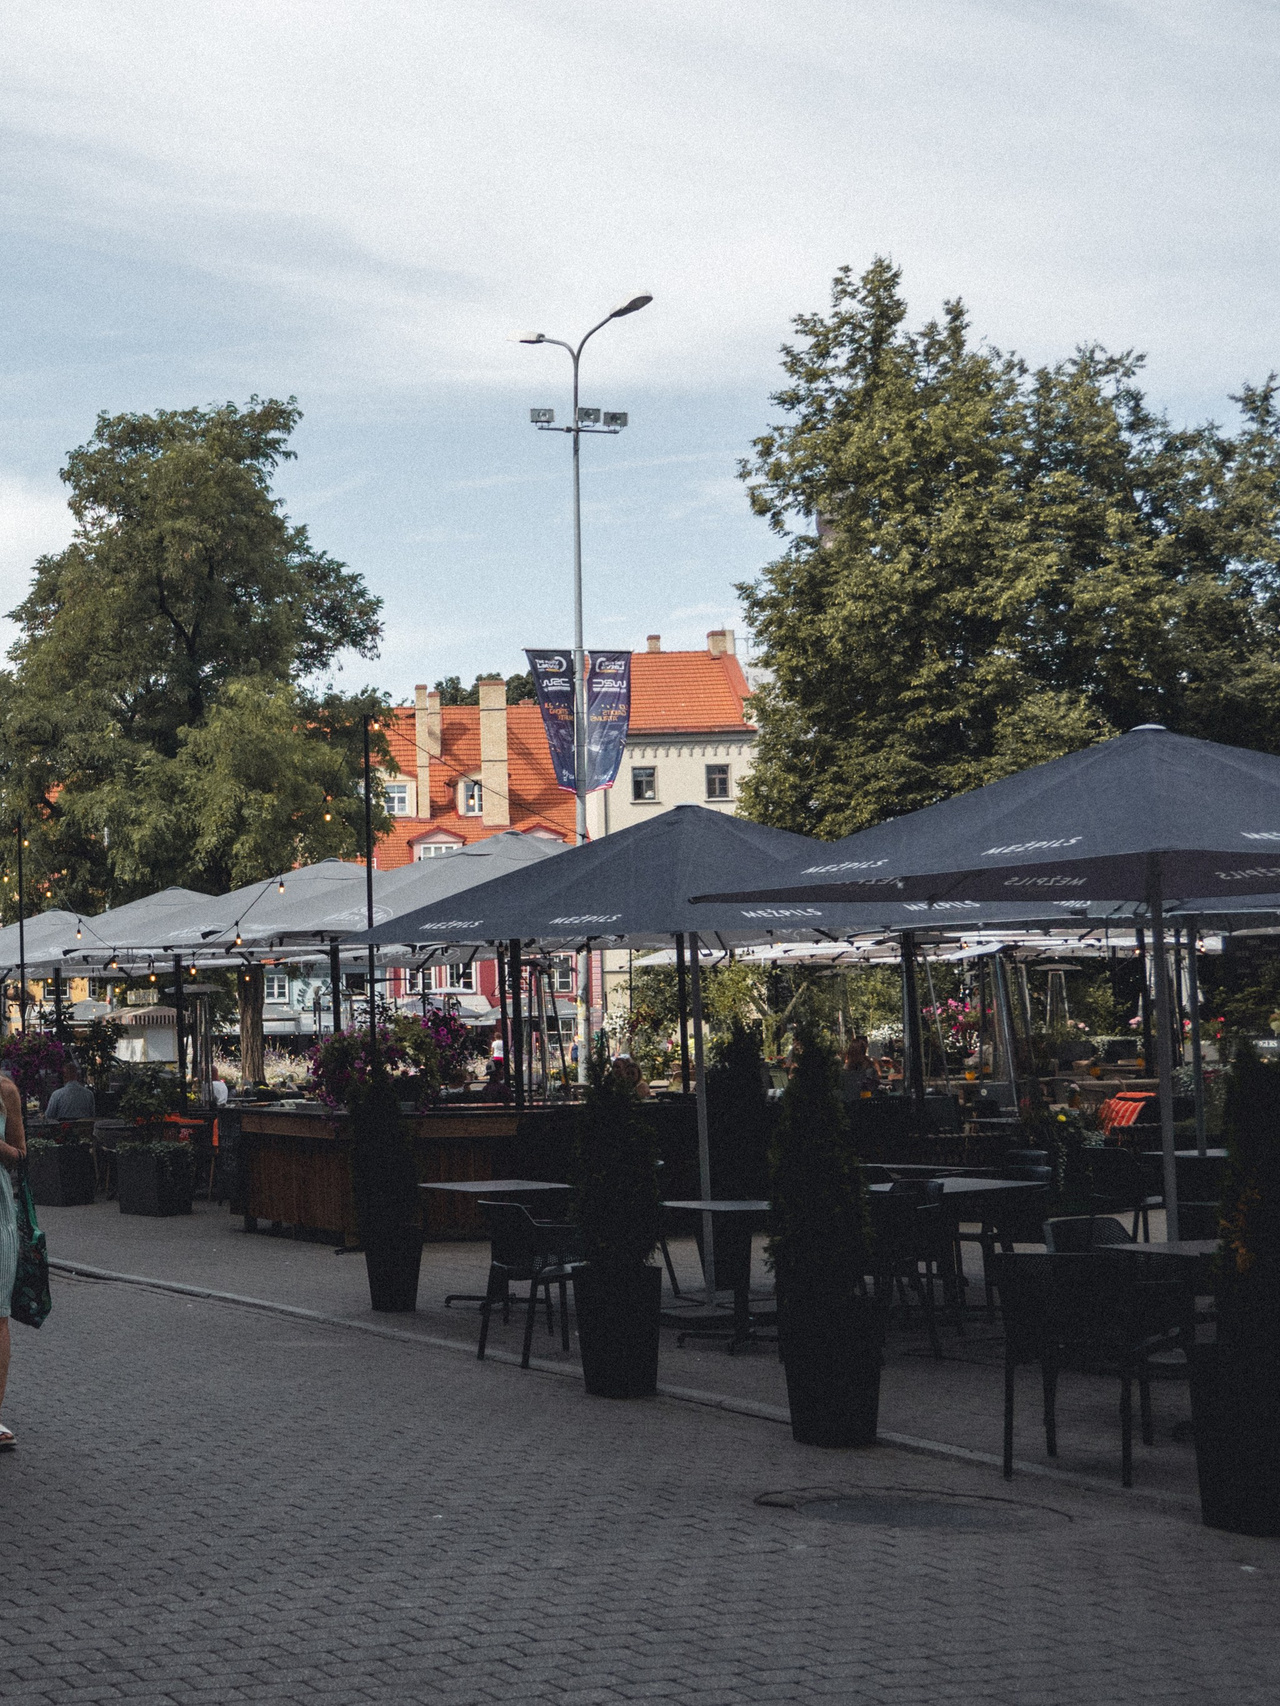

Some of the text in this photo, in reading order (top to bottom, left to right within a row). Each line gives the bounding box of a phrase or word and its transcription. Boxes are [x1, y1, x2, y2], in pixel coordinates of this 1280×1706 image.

[980, 836, 1084, 857] MEŽPILS
[800, 858, 890, 876] MEŽPILS
[547, 913, 623, 926] MEŽPILS
[740, 907, 823, 920] MEŽPILS
[418, 919, 485, 931] MEŽPILS
